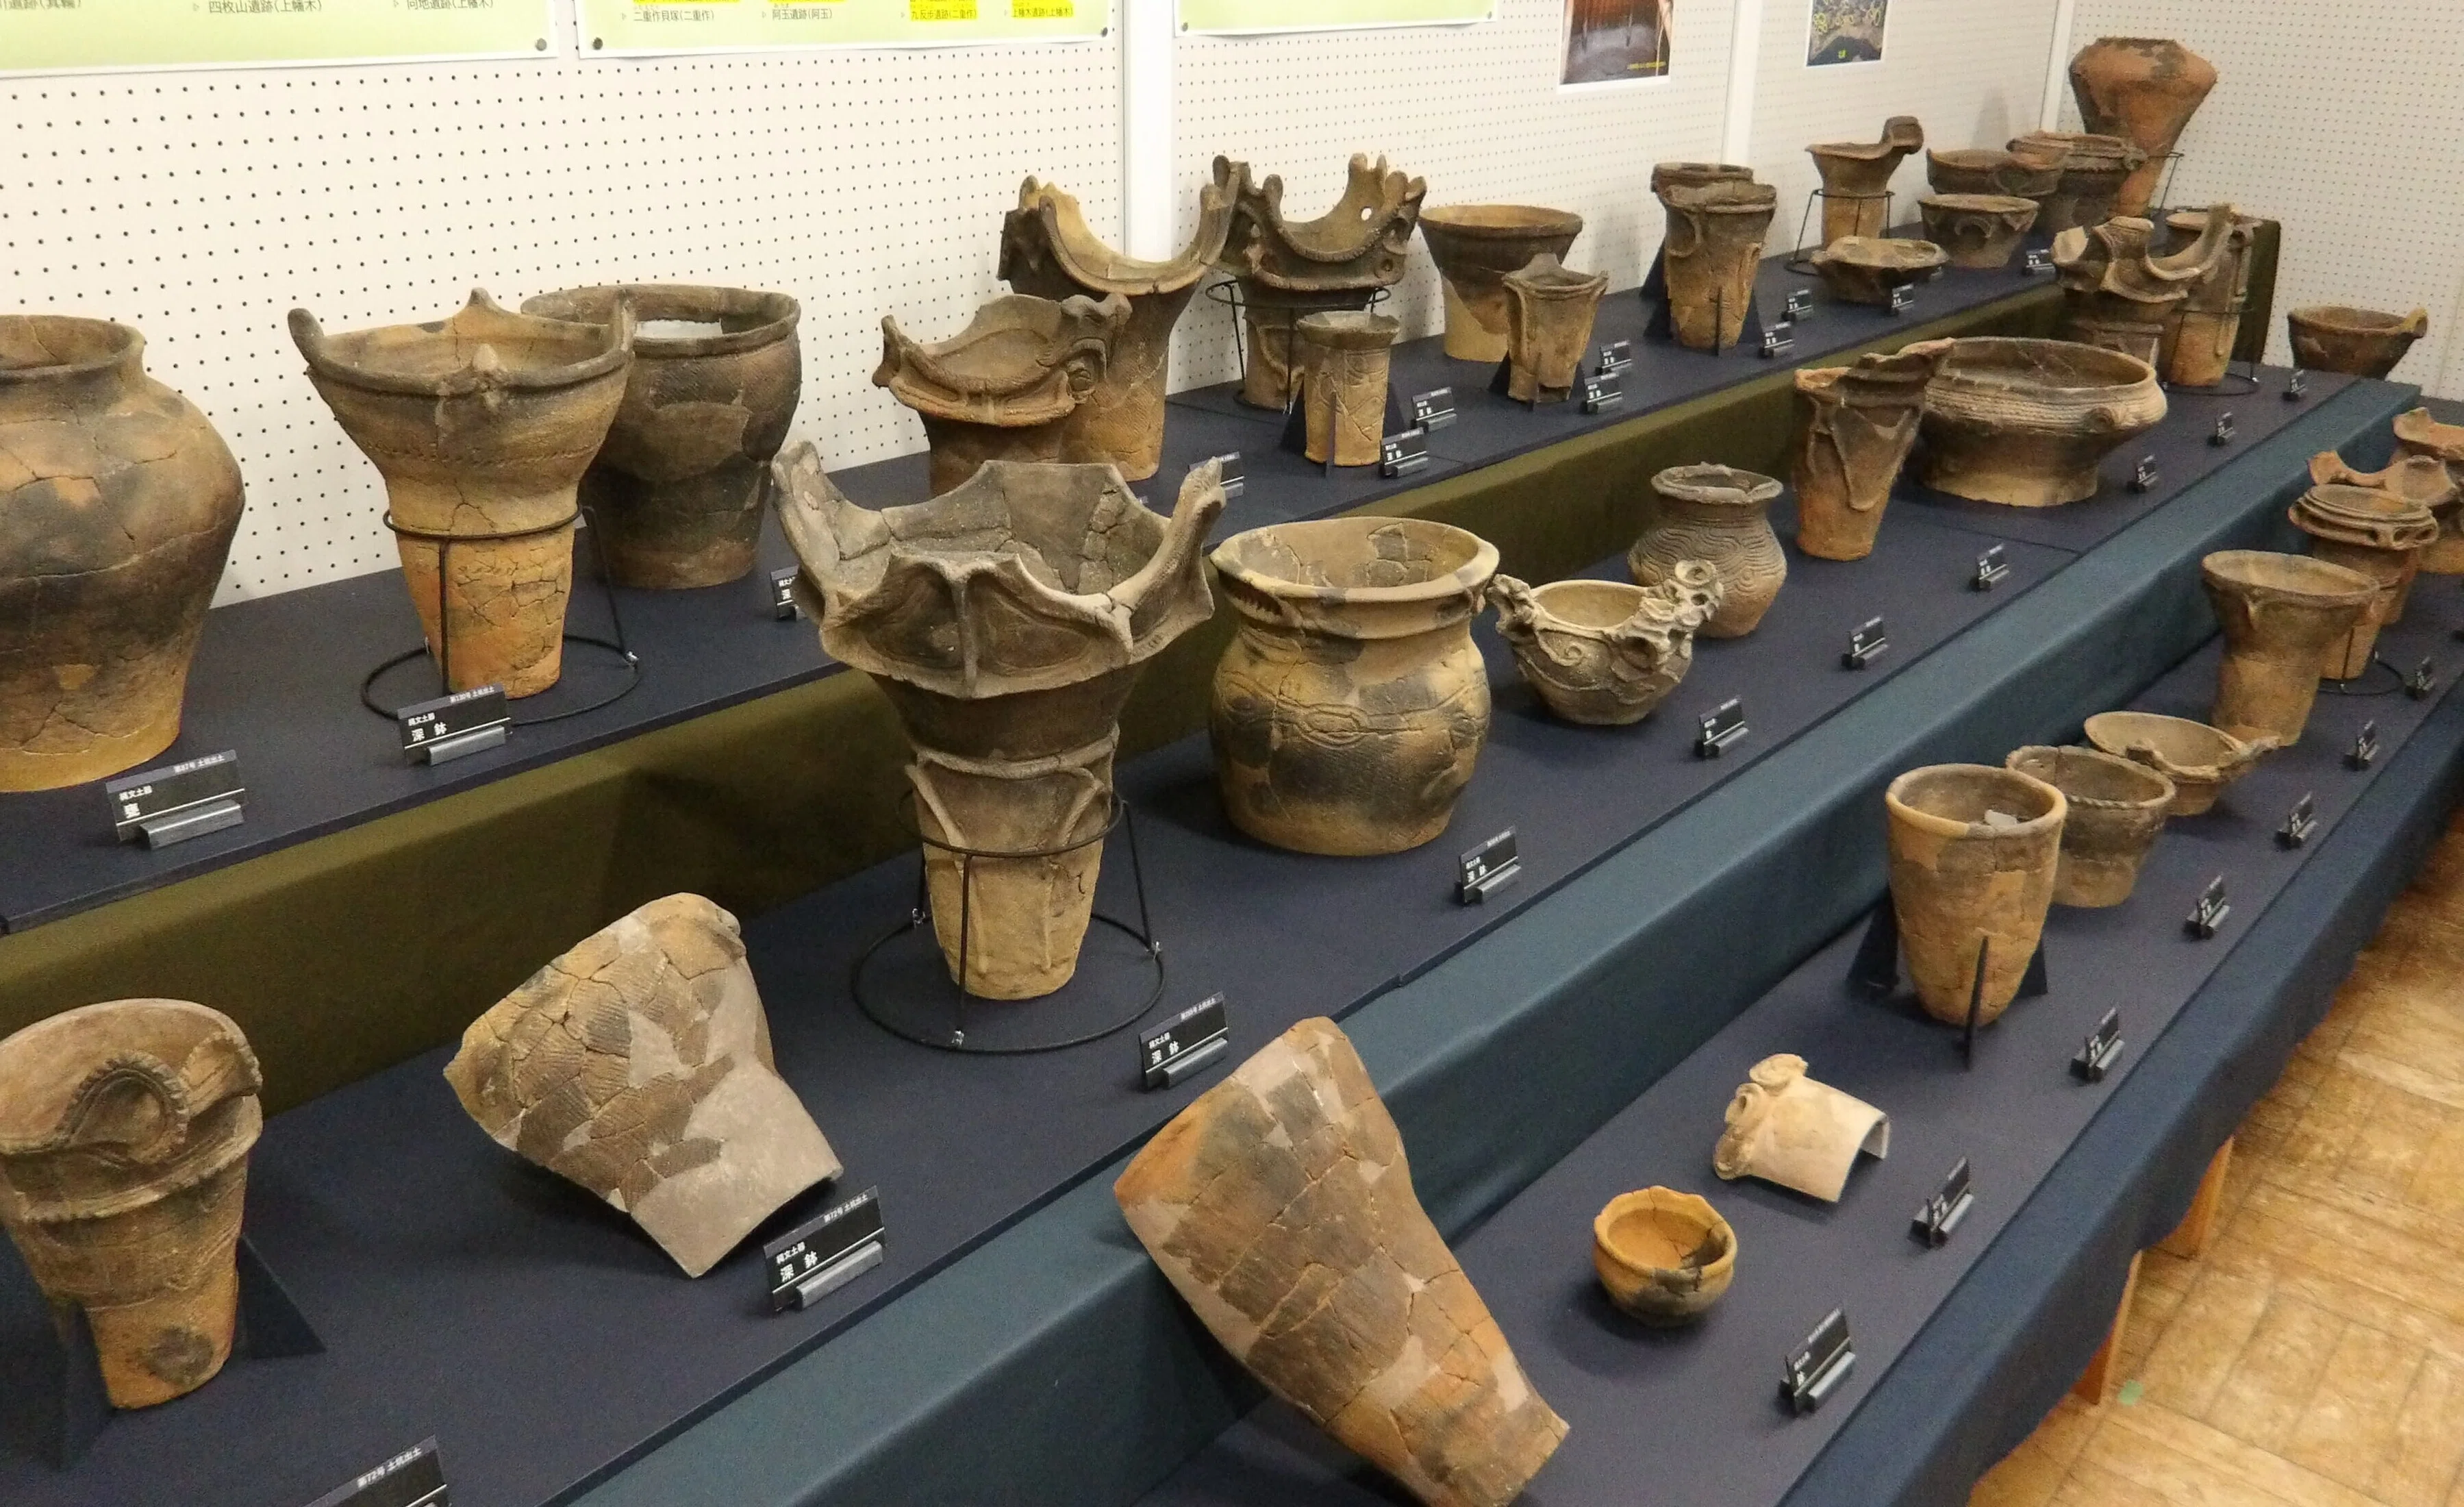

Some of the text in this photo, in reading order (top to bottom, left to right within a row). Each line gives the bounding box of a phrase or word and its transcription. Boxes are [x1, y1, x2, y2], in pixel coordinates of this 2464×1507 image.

[209, 0, 322, 14] 四枚山遺跡(上幡木)
[772, 8, 833, 20] 阿玉遺跡(阿玉)
[633, 10, 714, 22] 二重作貝塚(二重作)
[408, 712, 435, 726] 縄文土器
[412, 722, 447, 742] 深鉢
[119, 785, 153, 801] 縄文土器
[777, 1241, 805, 1265] 縄文土器
[780, 1250, 818, 1282] 深鉢
[357, 1465, 386, 1488] 第72号
